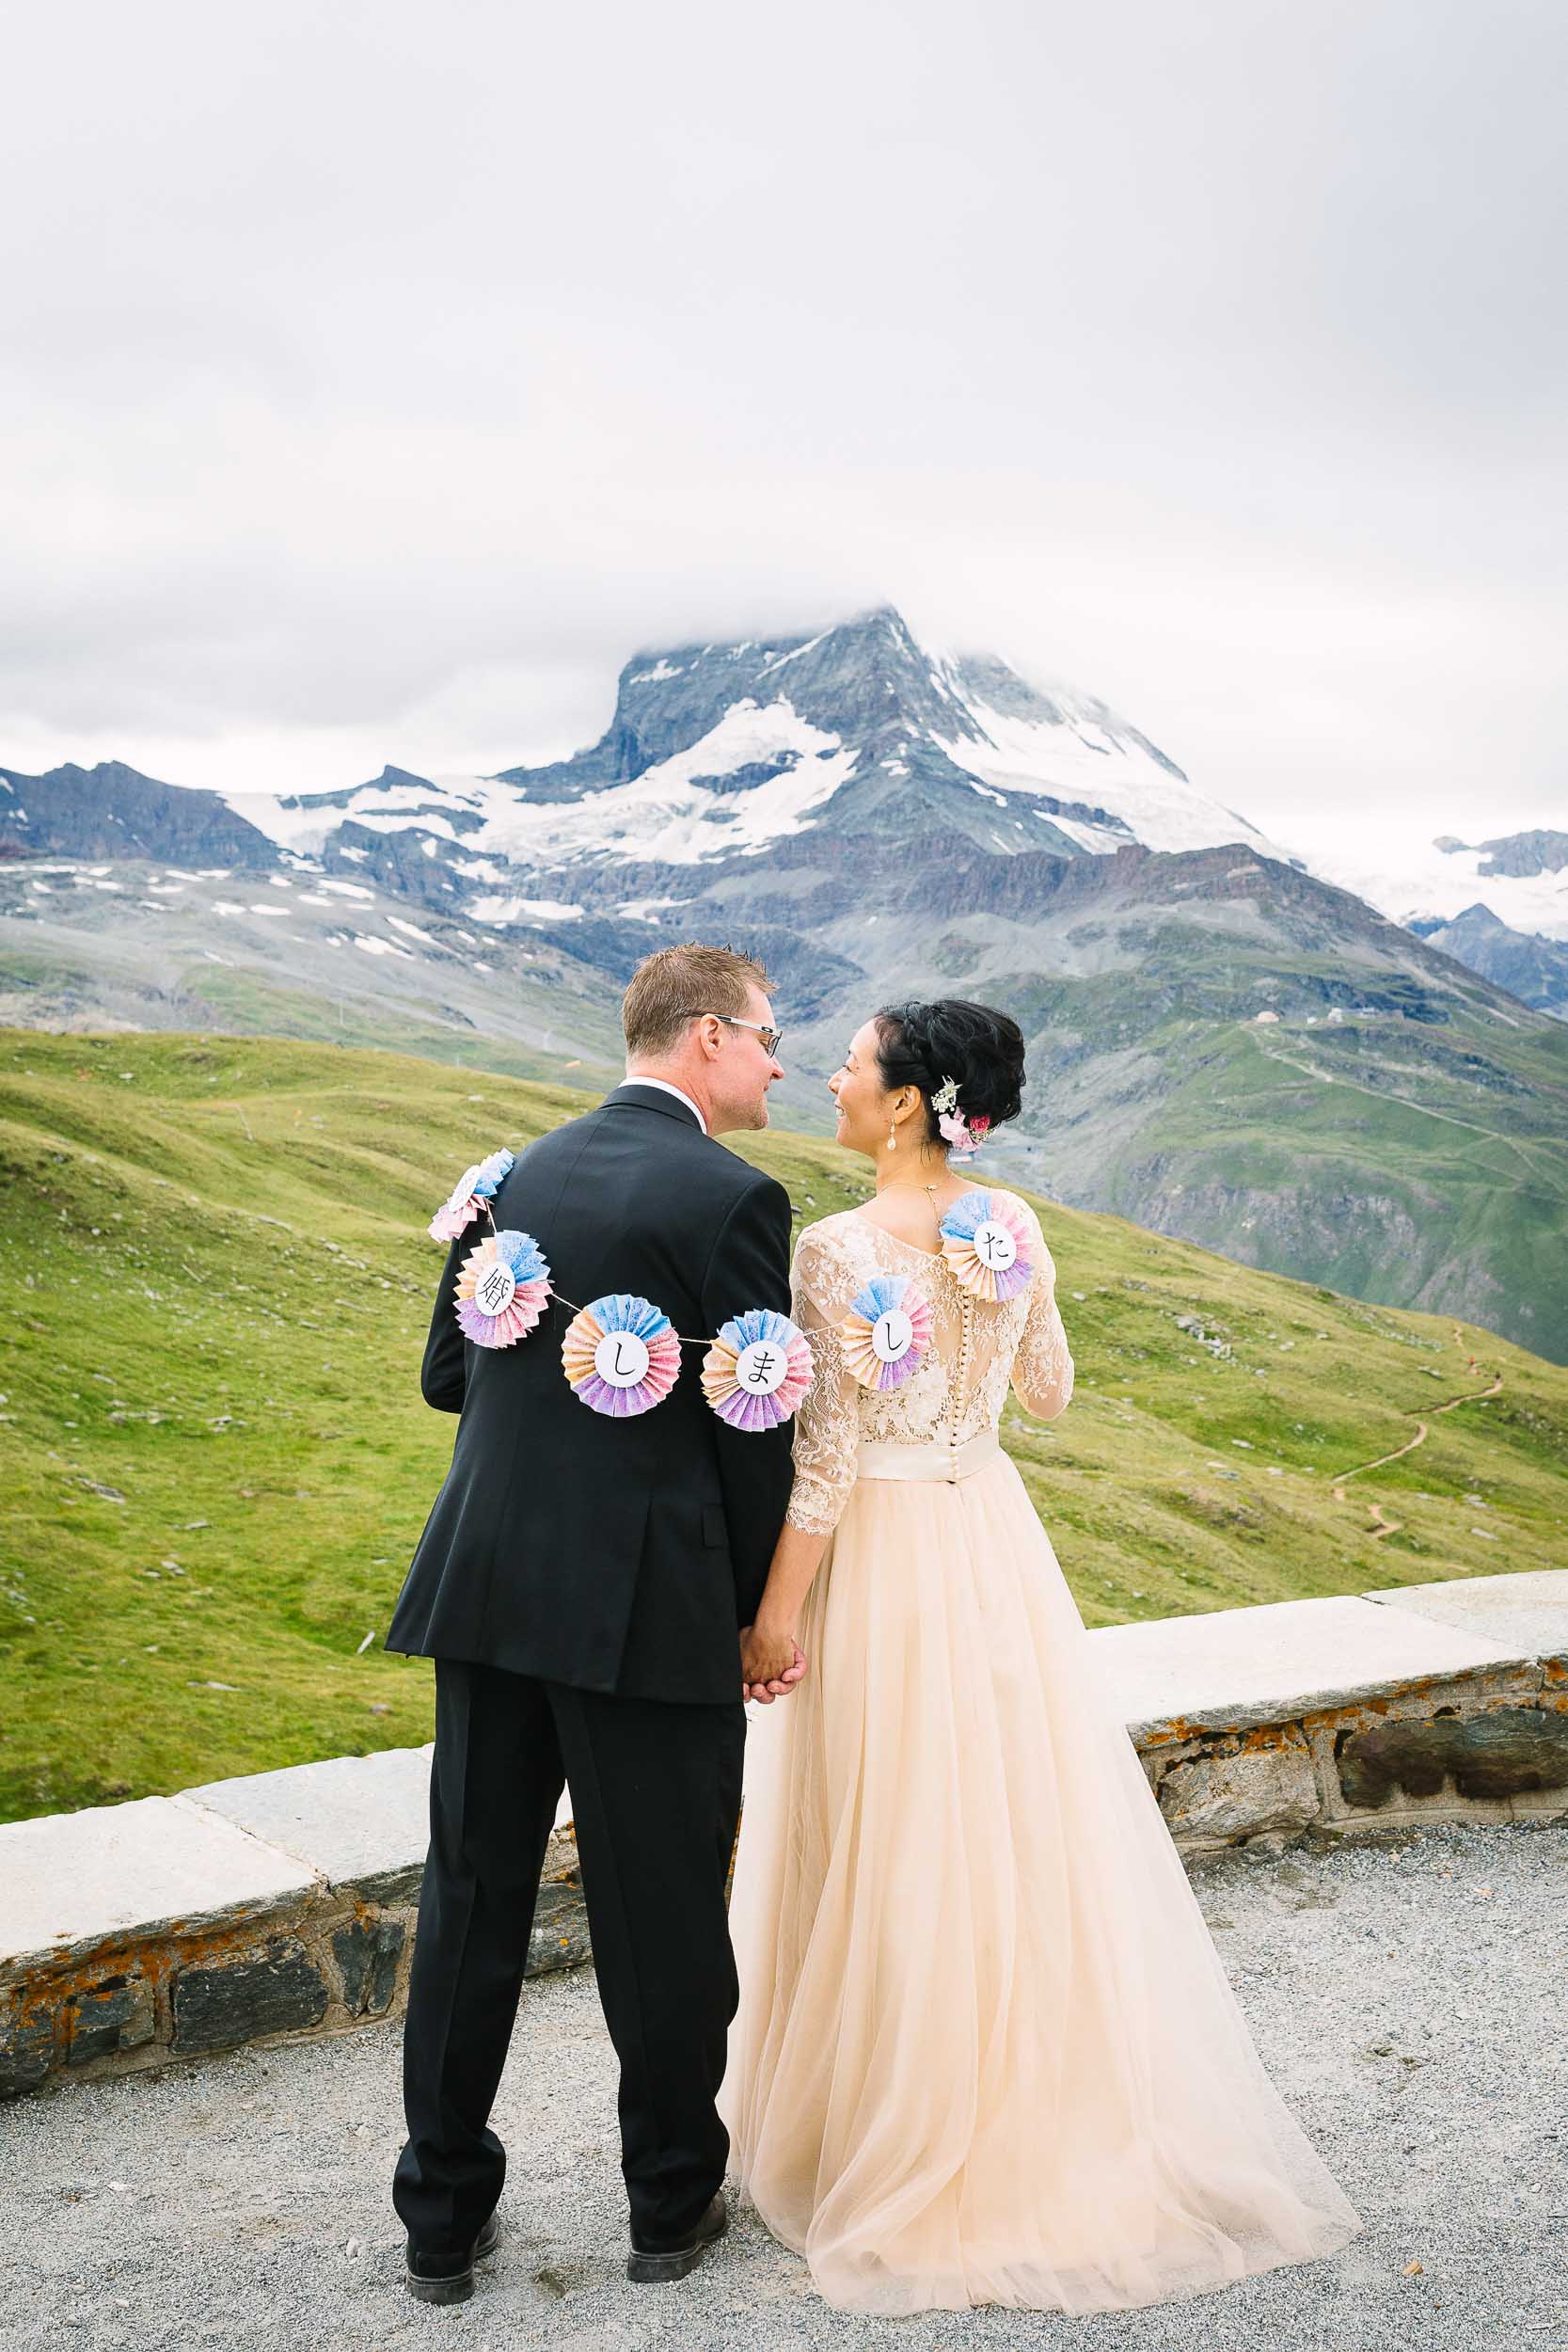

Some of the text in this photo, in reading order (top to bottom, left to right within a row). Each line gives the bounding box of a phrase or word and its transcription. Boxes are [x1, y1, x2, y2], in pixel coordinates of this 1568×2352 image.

[480, 1232, 1008, 1385] 婚 し ま し た
